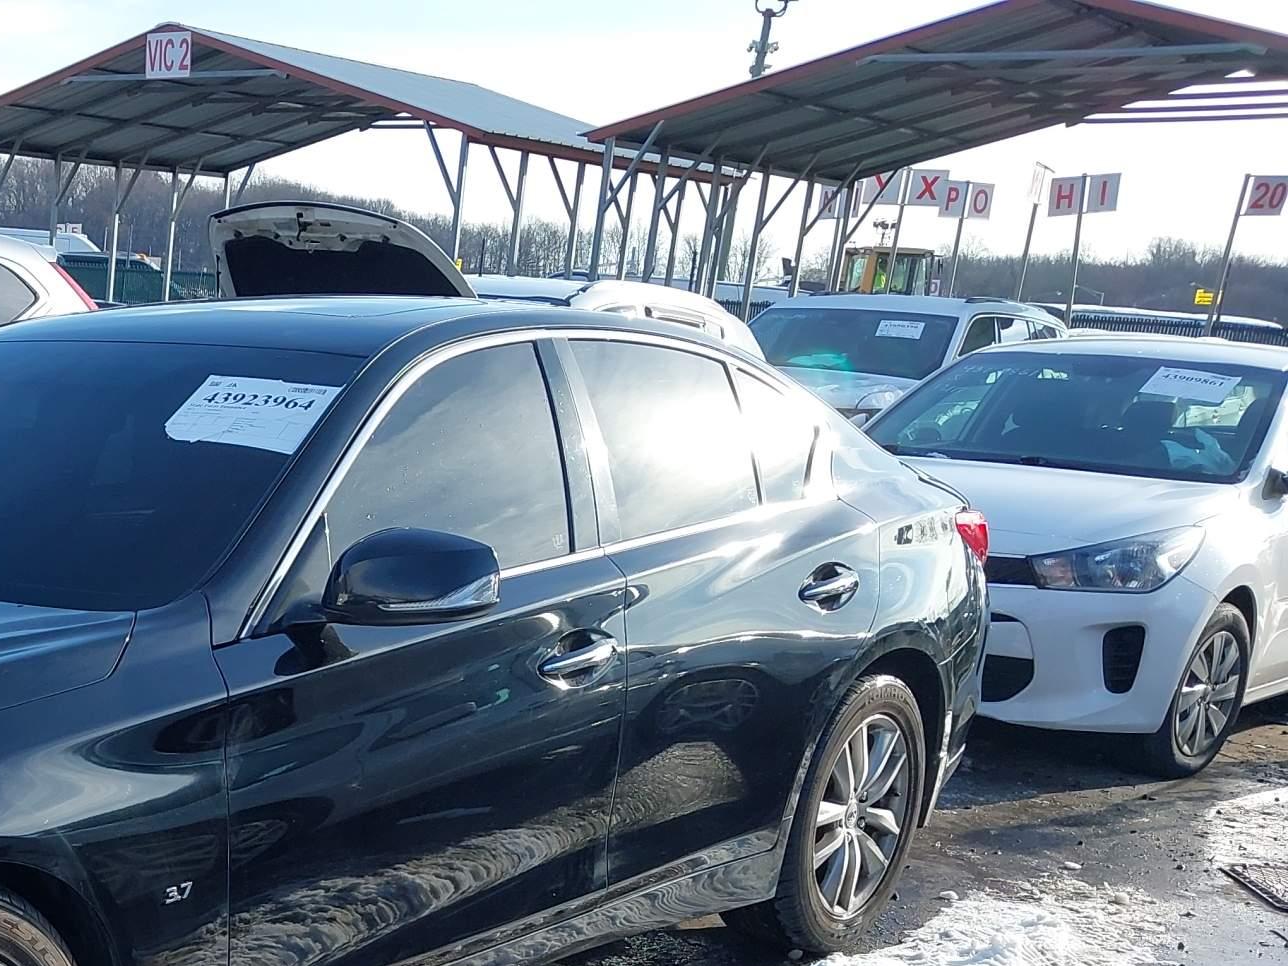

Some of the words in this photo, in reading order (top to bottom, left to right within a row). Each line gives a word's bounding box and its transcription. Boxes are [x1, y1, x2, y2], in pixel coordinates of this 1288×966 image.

[148, 38, 175, 72] VIC
[178, 38, 189, 71] 2
[916, 175, 941, 201] X
[944, 187, 960, 212] P
[972, 189, 989, 214] O
[1055, 183, 1075, 210] H
[1249, 182, 1287, 209] 20
[203, 391, 316, 411] 43923964
